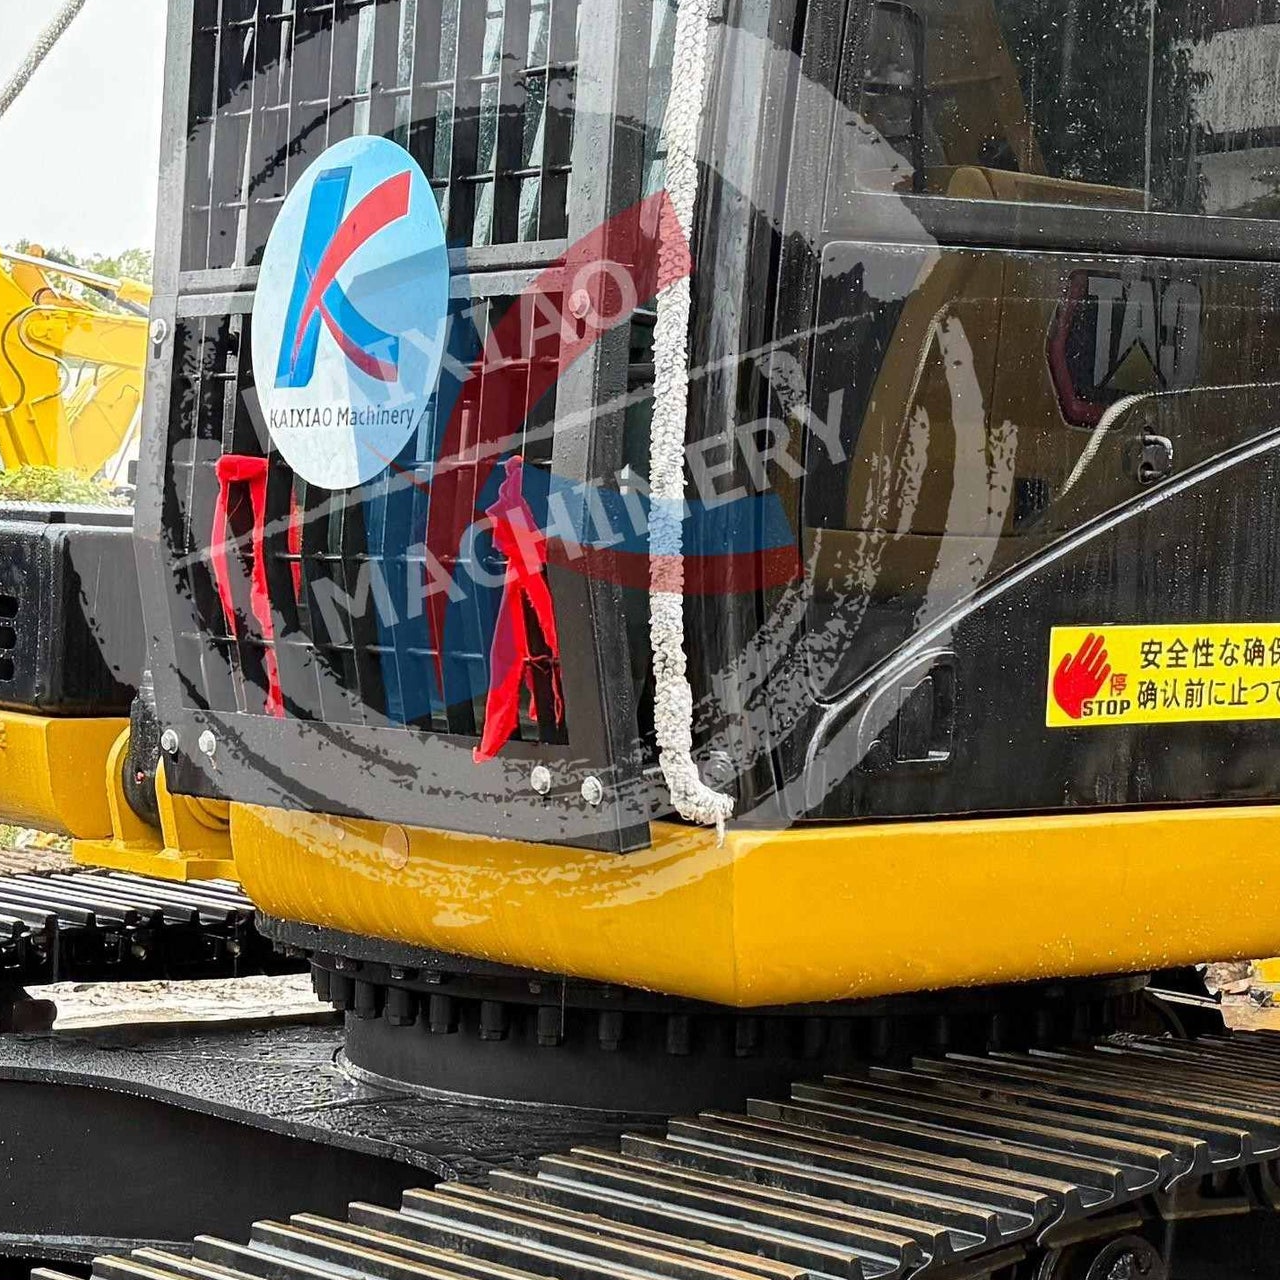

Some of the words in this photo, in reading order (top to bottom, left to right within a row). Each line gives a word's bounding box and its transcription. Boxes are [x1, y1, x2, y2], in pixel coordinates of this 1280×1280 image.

[269, 407, 333, 429] KAIXIAO
[336, 404, 415, 430] Machinery
[1082, 698, 1131, 718] STOP
